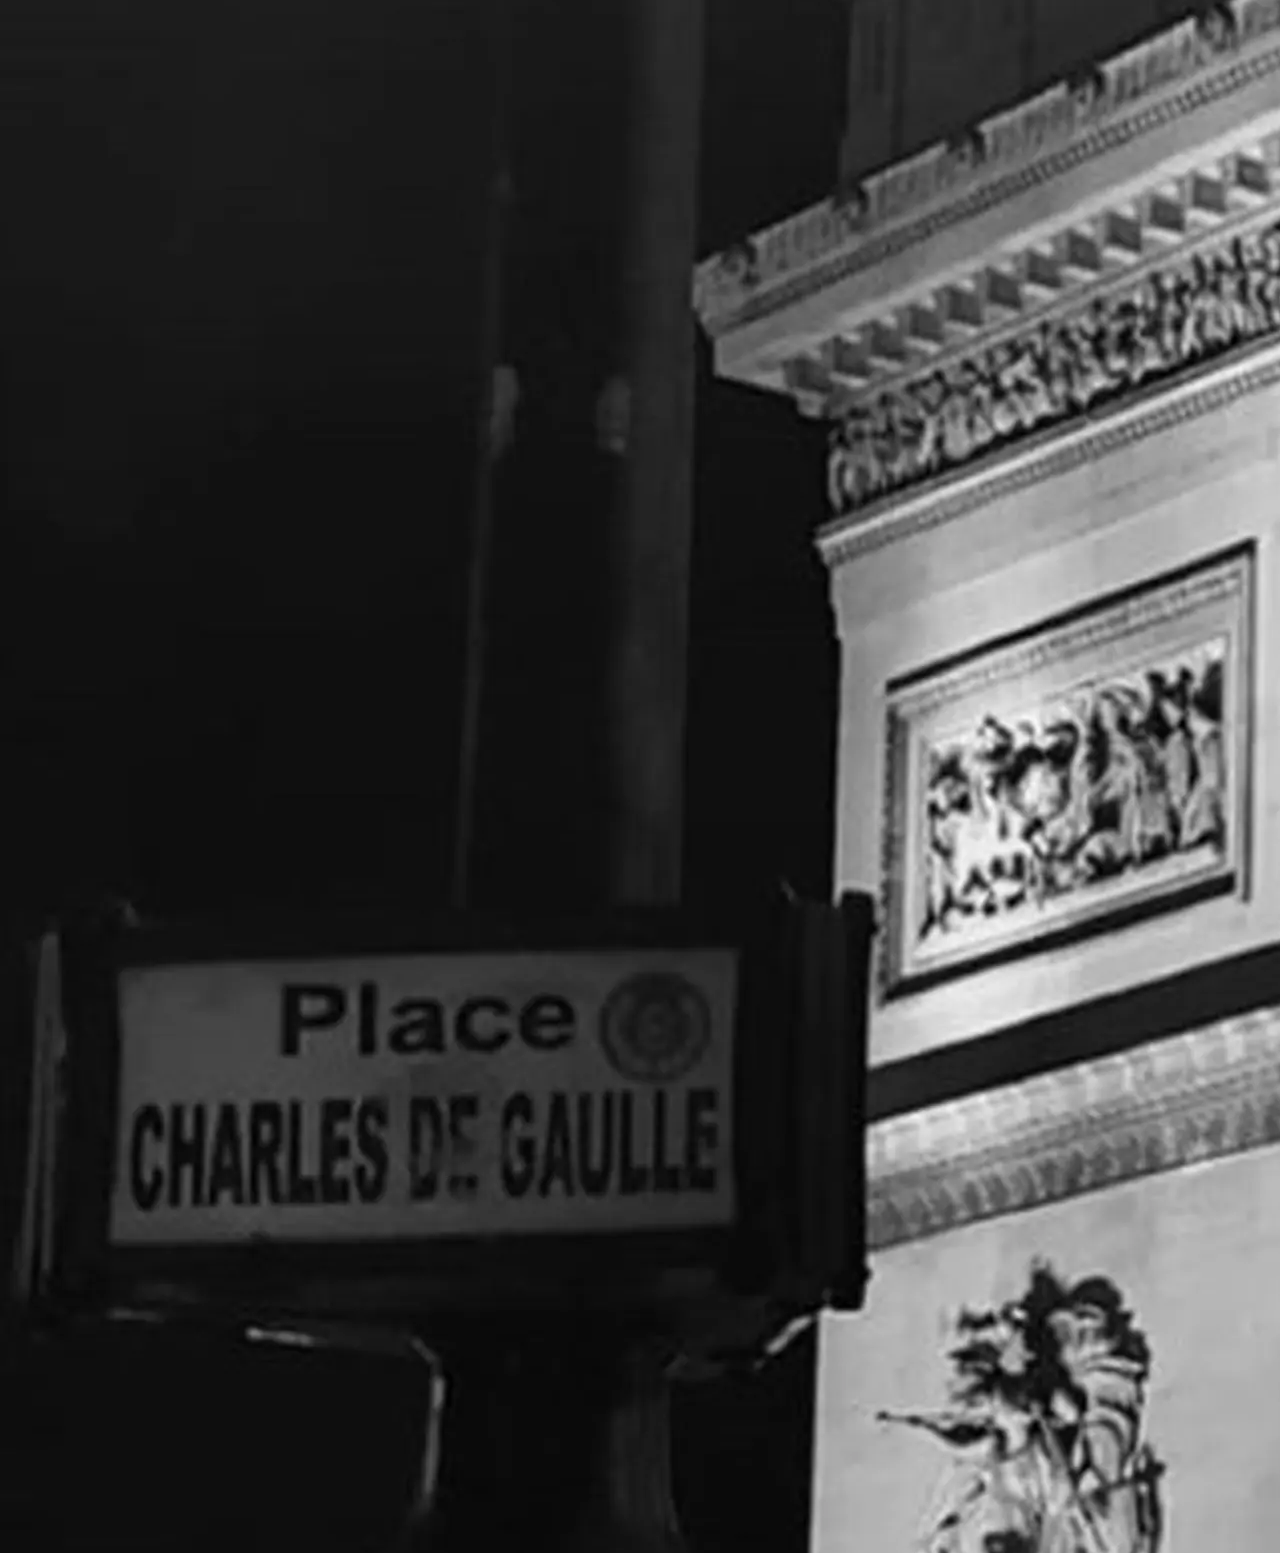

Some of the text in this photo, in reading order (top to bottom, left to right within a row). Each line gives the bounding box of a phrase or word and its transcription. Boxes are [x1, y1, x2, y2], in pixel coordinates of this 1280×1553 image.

[278, 980, 577, 1058] Place
[130, 1096, 389, 1212] CHARLES
[500, 1087, 719, 1199] GAULLE
